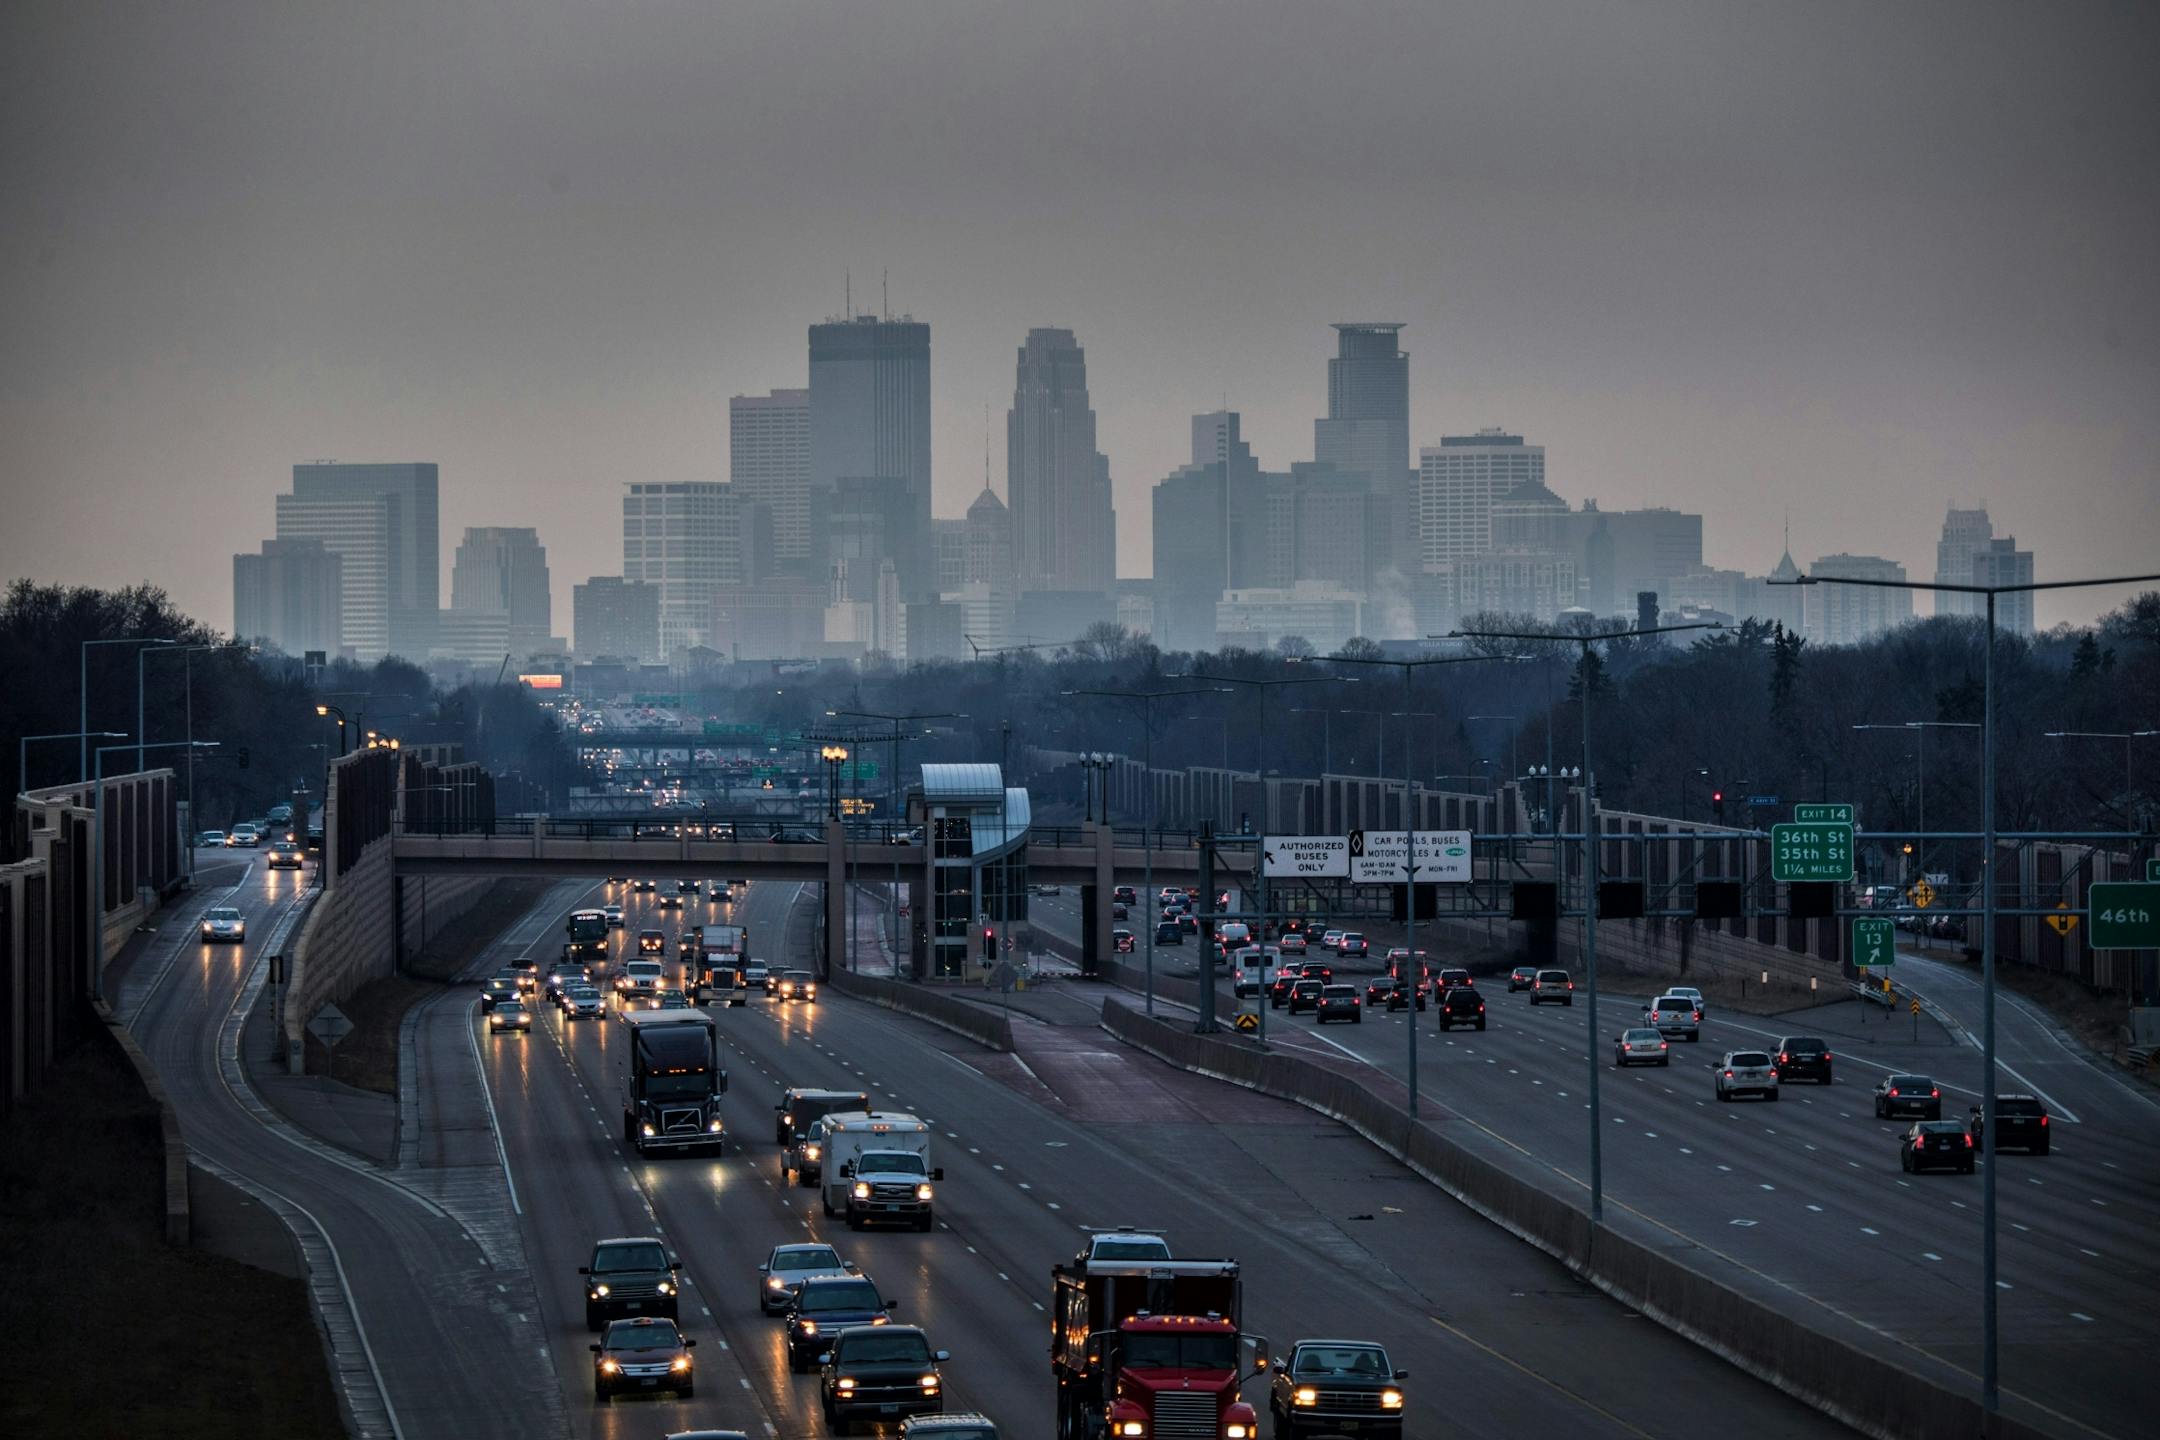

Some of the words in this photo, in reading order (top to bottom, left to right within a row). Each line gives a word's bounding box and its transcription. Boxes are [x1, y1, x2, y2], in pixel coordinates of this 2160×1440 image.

[1801, 810, 1825, 818] EXIT
[1830, 808, 1847, 819] 14
[1374, 837, 1391, 845] CAR
[1397, 837, 1429, 846] POLS,
[1432, 836, 1460, 845] BUSES
[1781, 831, 1819, 843] 36th
[1828, 831, 1845, 843] St
[1279, 842, 1344, 850] AUTHORIZED
[1294, 852, 1329, 860] BUSES
[1368, 849, 1429, 858] MOTORCYLES
[1434, 849, 1440, 857] &
[1780, 848, 1819, 860] 35th
[1828, 848, 1845, 860] St
[1298, 863, 1325, 871] ONLY
[1811, 865, 1842, 873] MILES
[2099, 908, 2149, 923] 46th
[1859, 922, 1889, 931] EXIT
[1866, 933, 1882, 945] 13
